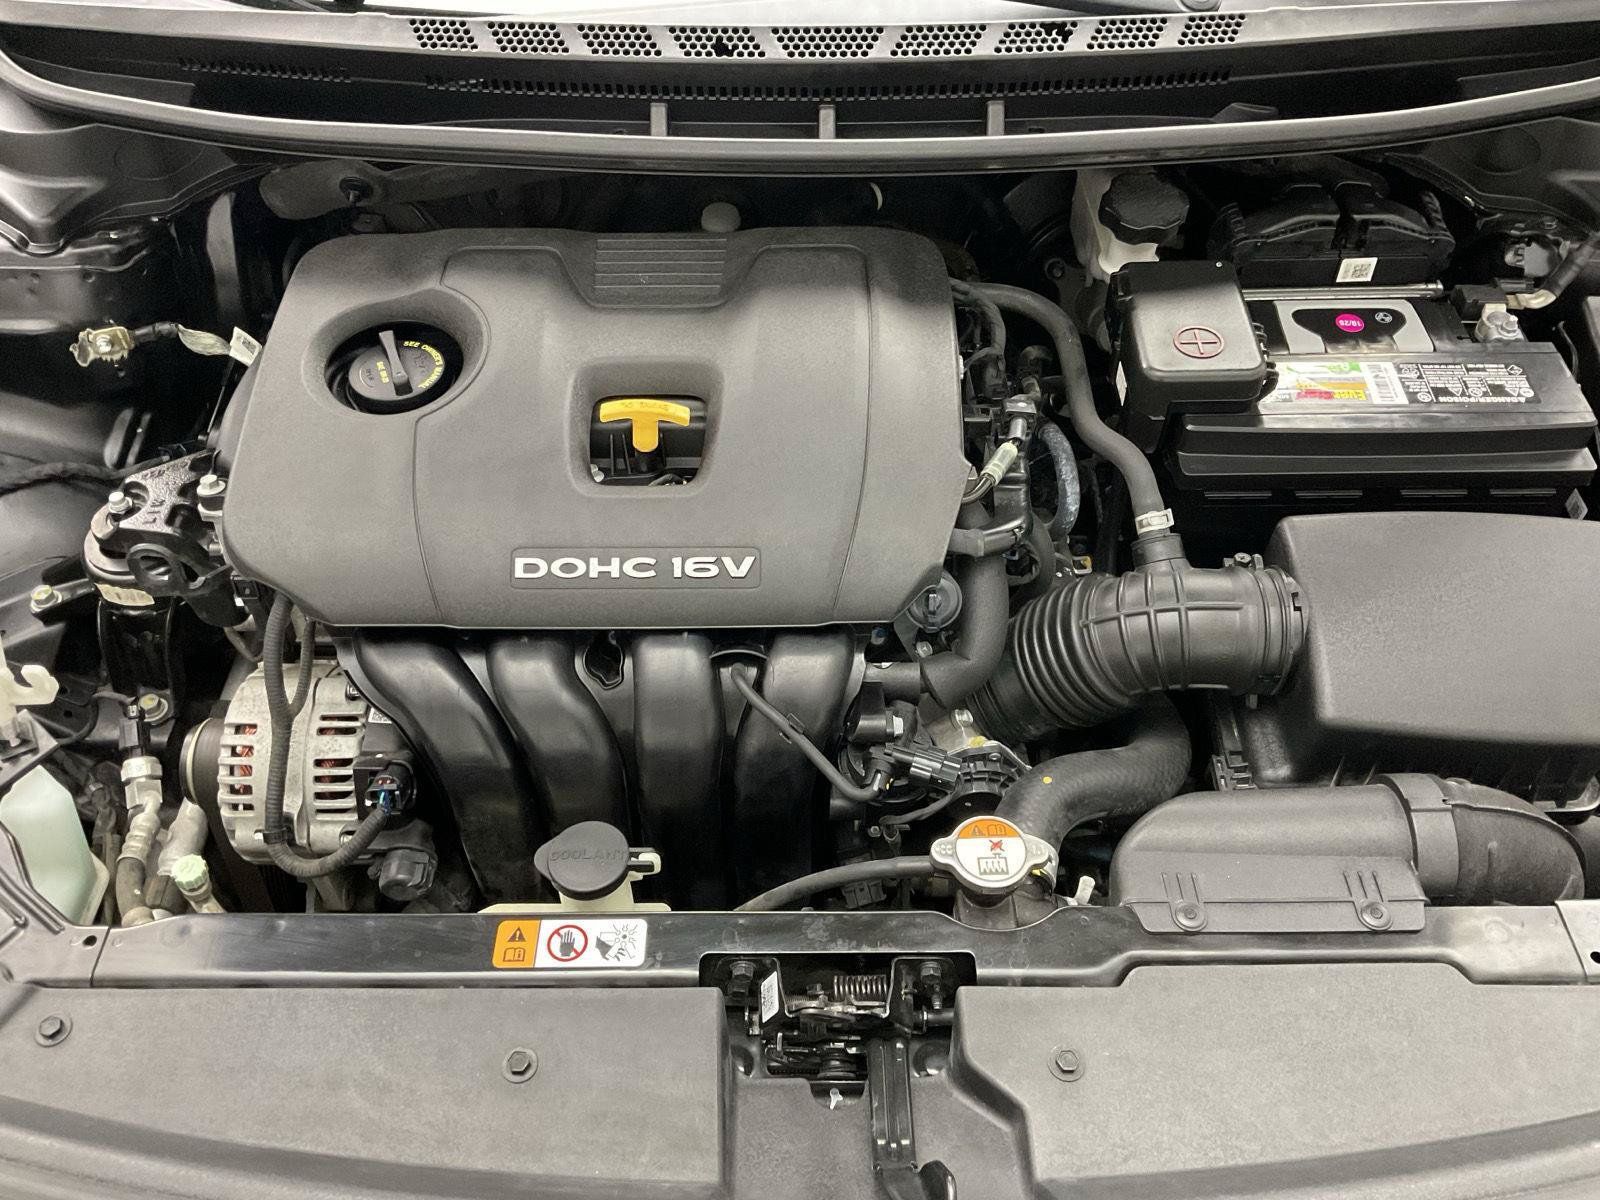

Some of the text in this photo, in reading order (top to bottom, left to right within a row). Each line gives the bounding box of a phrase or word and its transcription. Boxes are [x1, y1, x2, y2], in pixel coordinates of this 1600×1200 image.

[514, 556, 756, 579] DOHC 16V
[550, 847, 626, 862] COOLANT
